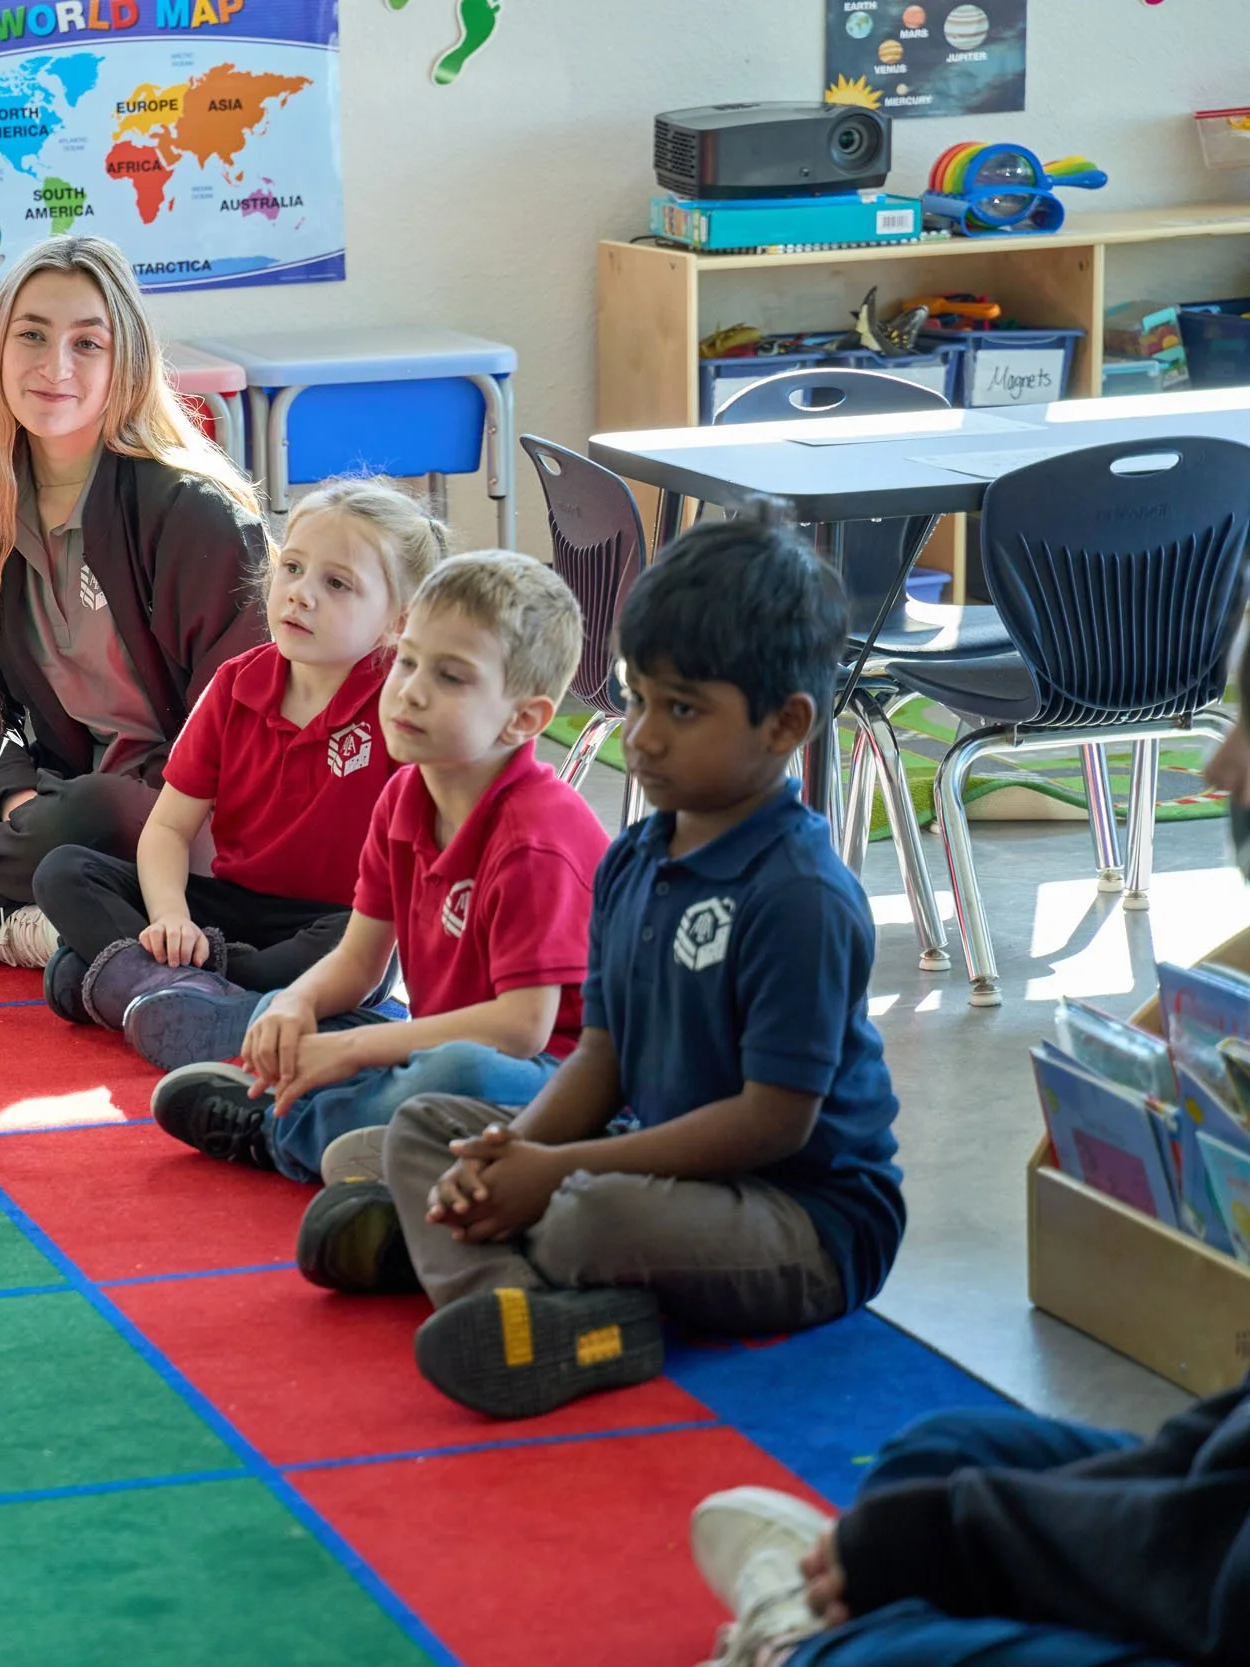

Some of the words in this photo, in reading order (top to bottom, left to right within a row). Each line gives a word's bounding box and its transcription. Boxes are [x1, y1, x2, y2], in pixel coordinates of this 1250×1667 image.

[844, 1, 878, 11] EARTH
[155, 0, 244, 28] MAP
[900, 29, 929, 38] MARS
[946, 52, 987, 63] JUPITER
[874, 64, 907, 73] VENUS
[116, 99, 178, 113] EUROPE
[208, 99, 243, 111] ASIA
[884, 96, 932, 106] MERCURY
[107, 160, 162, 173] AFRICA
[33, 188, 85, 201] SOUTH
[220, 196, 304, 212] AUSTRALIA
[25, 205, 94, 220] AMERICA
[133, 260, 212, 275] TARCTICA
[987, 366, 1052, 400] Magnets
